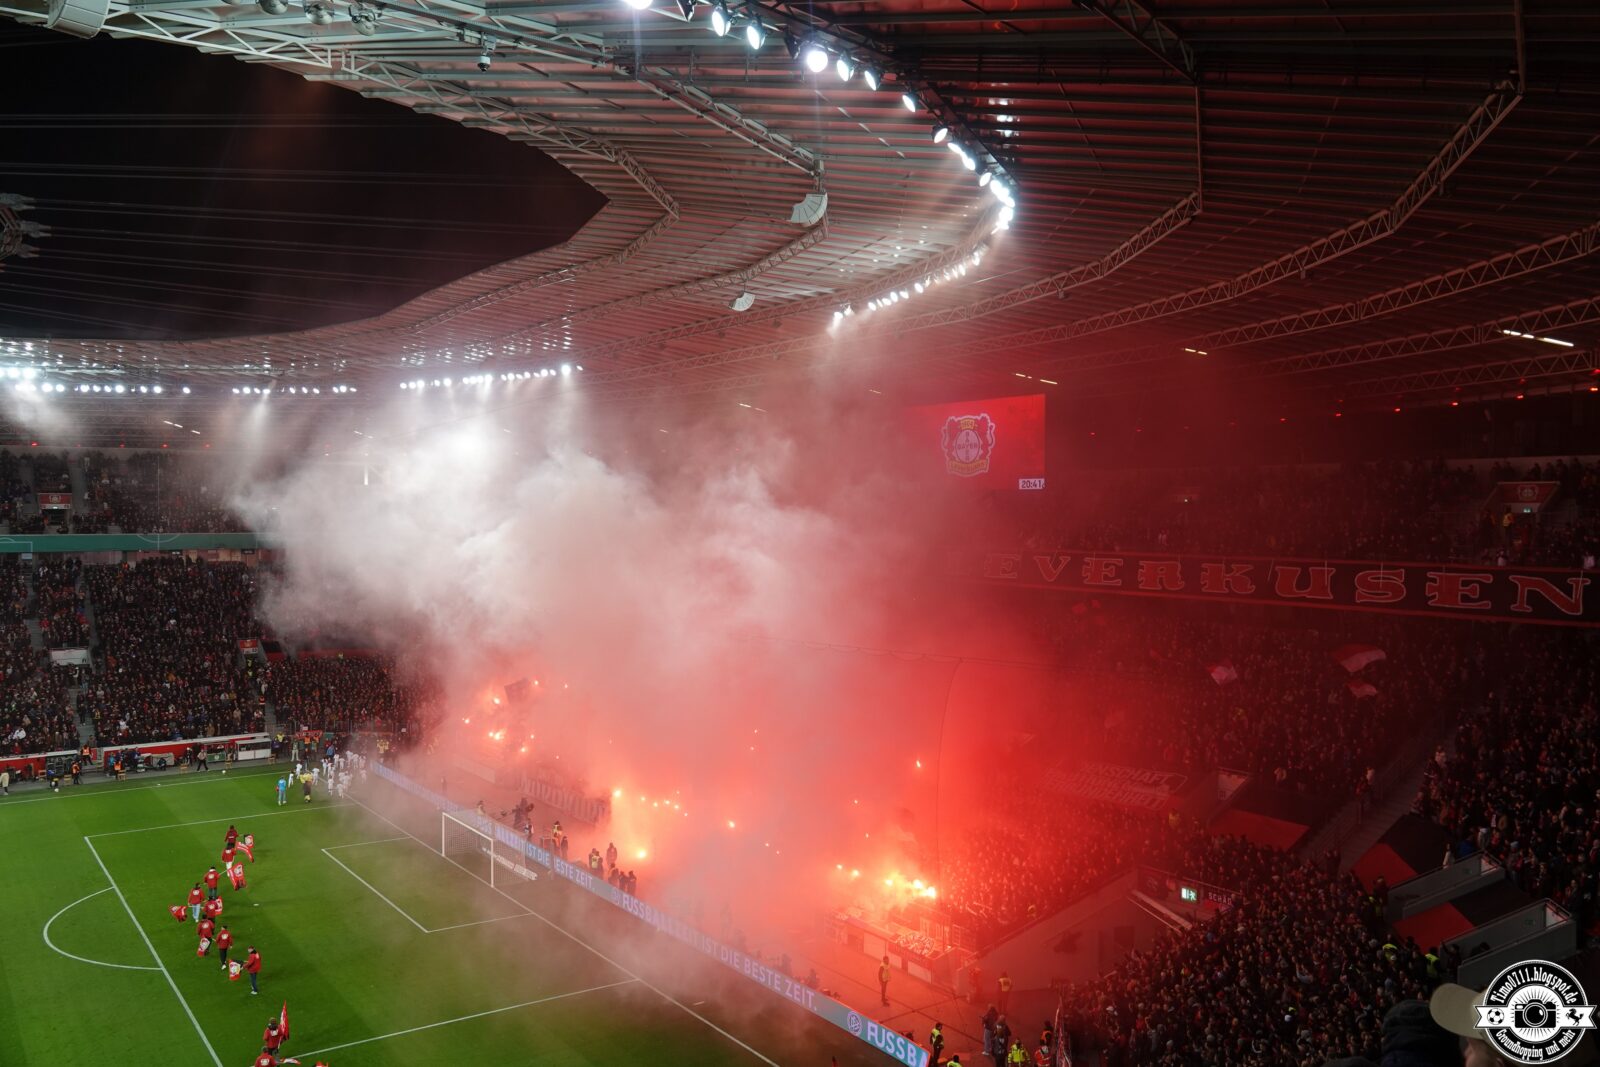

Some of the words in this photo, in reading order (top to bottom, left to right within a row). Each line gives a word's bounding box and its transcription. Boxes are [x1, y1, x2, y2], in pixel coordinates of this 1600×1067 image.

[1021, 480, 1042, 489] 20:41
[537, 848, 550, 866] DIE
[575, 868, 595, 890] ZEIT.
[701, 935, 718, 955] IST
[721, 944, 740, 968] DIE
[743, 958, 781, 991] BESTE
[784, 979, 818, 1011] ZEIT.
